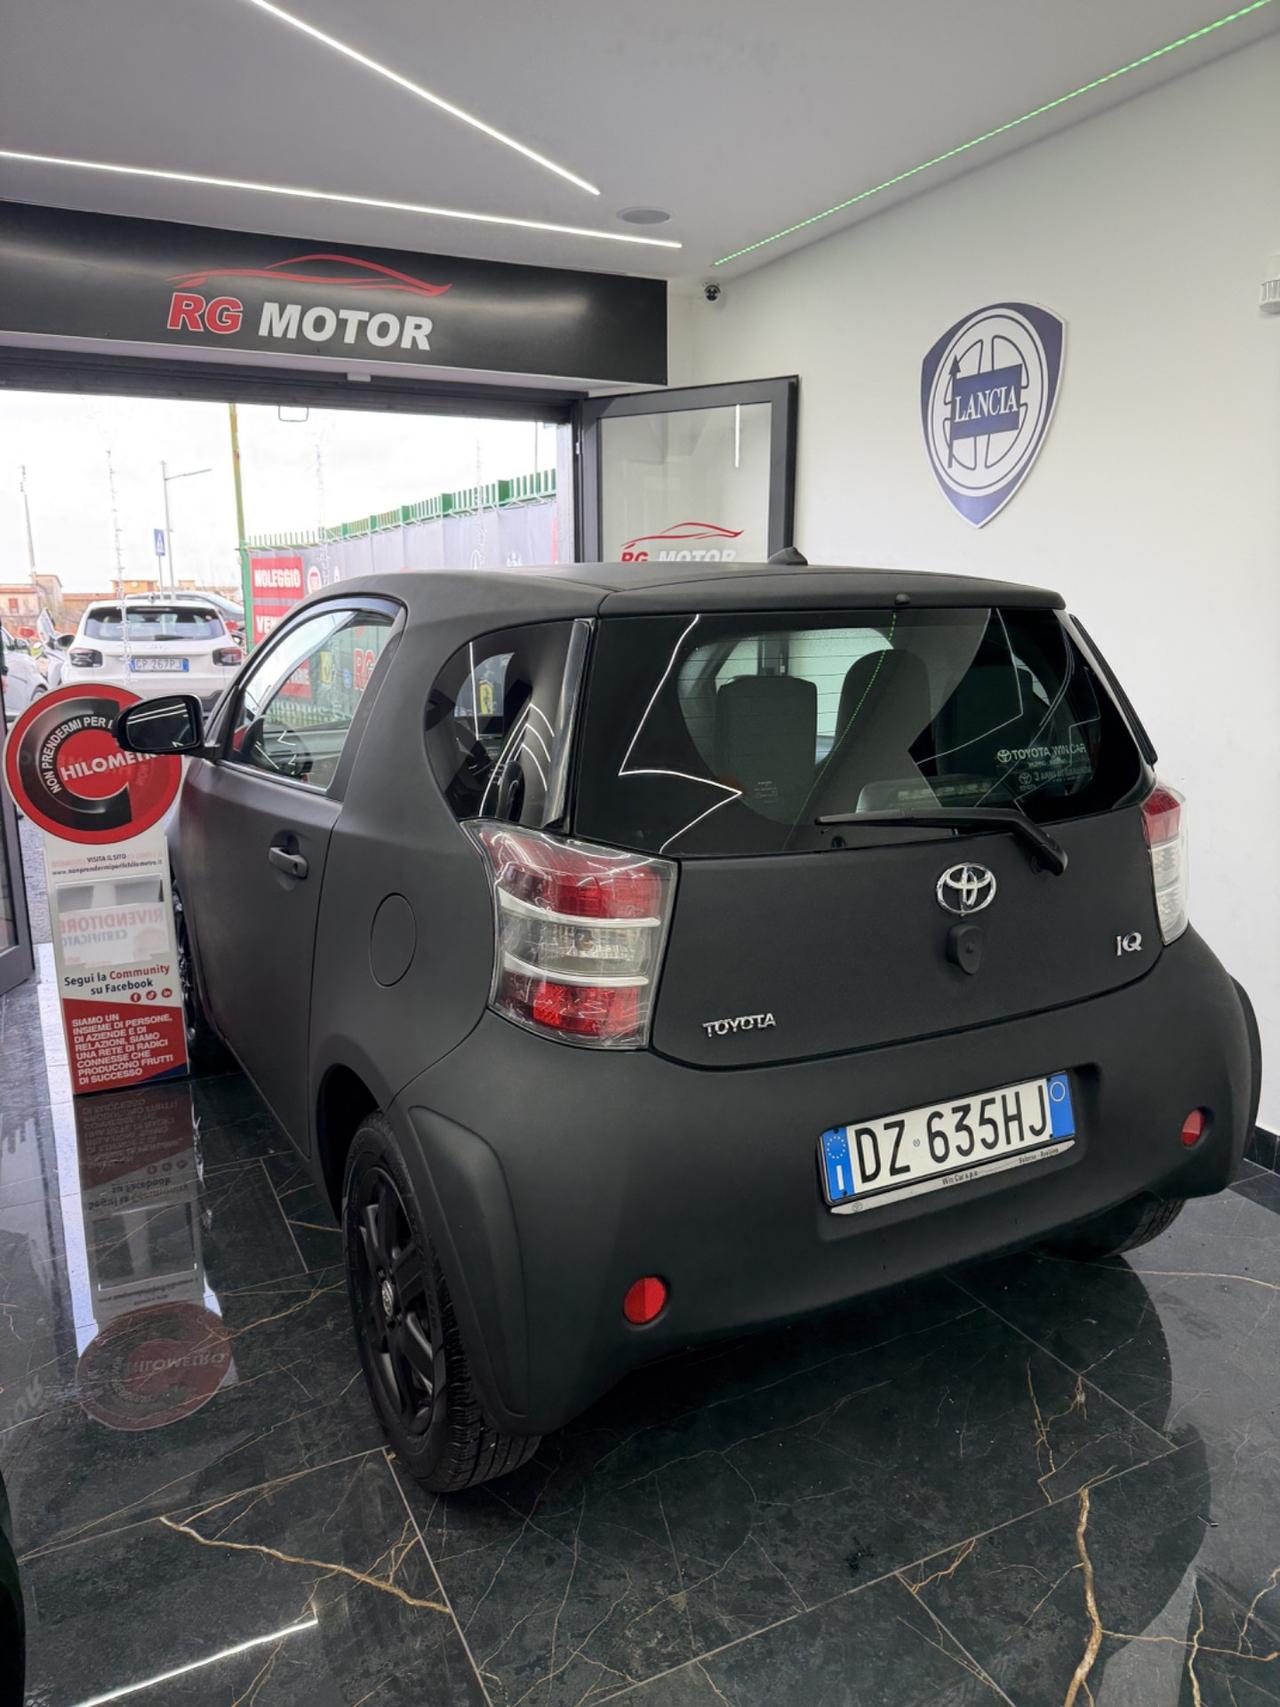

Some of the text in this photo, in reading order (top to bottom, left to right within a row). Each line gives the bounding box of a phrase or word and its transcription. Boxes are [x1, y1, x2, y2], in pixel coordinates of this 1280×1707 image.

[167, 292, 433, 350] RG MOTOR
[954, 385, 1019, 423] LANCIA
[83, 716, 106, 727] PER
[41, 718, 82, 769] PRENDERMI
[1011, 747, 1051, 760] TOYOTA
[43, 771, 62, 794] NON
[64, 964, 170, 986] Segui la Community
[90, 978, 153, 995] su Facebook
[72, 1014, 119, 1027] SIAMO UN
[73, 1023, 112, 1034] INSIEME
[114, 1021, 123, 1029] DI
[703, 1013, 776, 1037] TOYOTA
[86, 1029, 126, 1042] AZIENDE
[137, 1026, 146, 1034] DI
[129, 1032, 160, 1043] SIAMO
[76, 1051, 97, 1060] UNA
[99, 1046, 124, 1056] RETE
[137, 1039, 168, 1050] RADICI
[77, 1050, 151, 1068] CONNESSE CHE
[79, 1054, 173, 1076] PRODUCONO FRUTTI
[79, 1068, 143, 1085] DI SUCCESSO
[855, 1119, 911, 1184] DZ
[926, 1085, 1047, 1164] 635HJ
